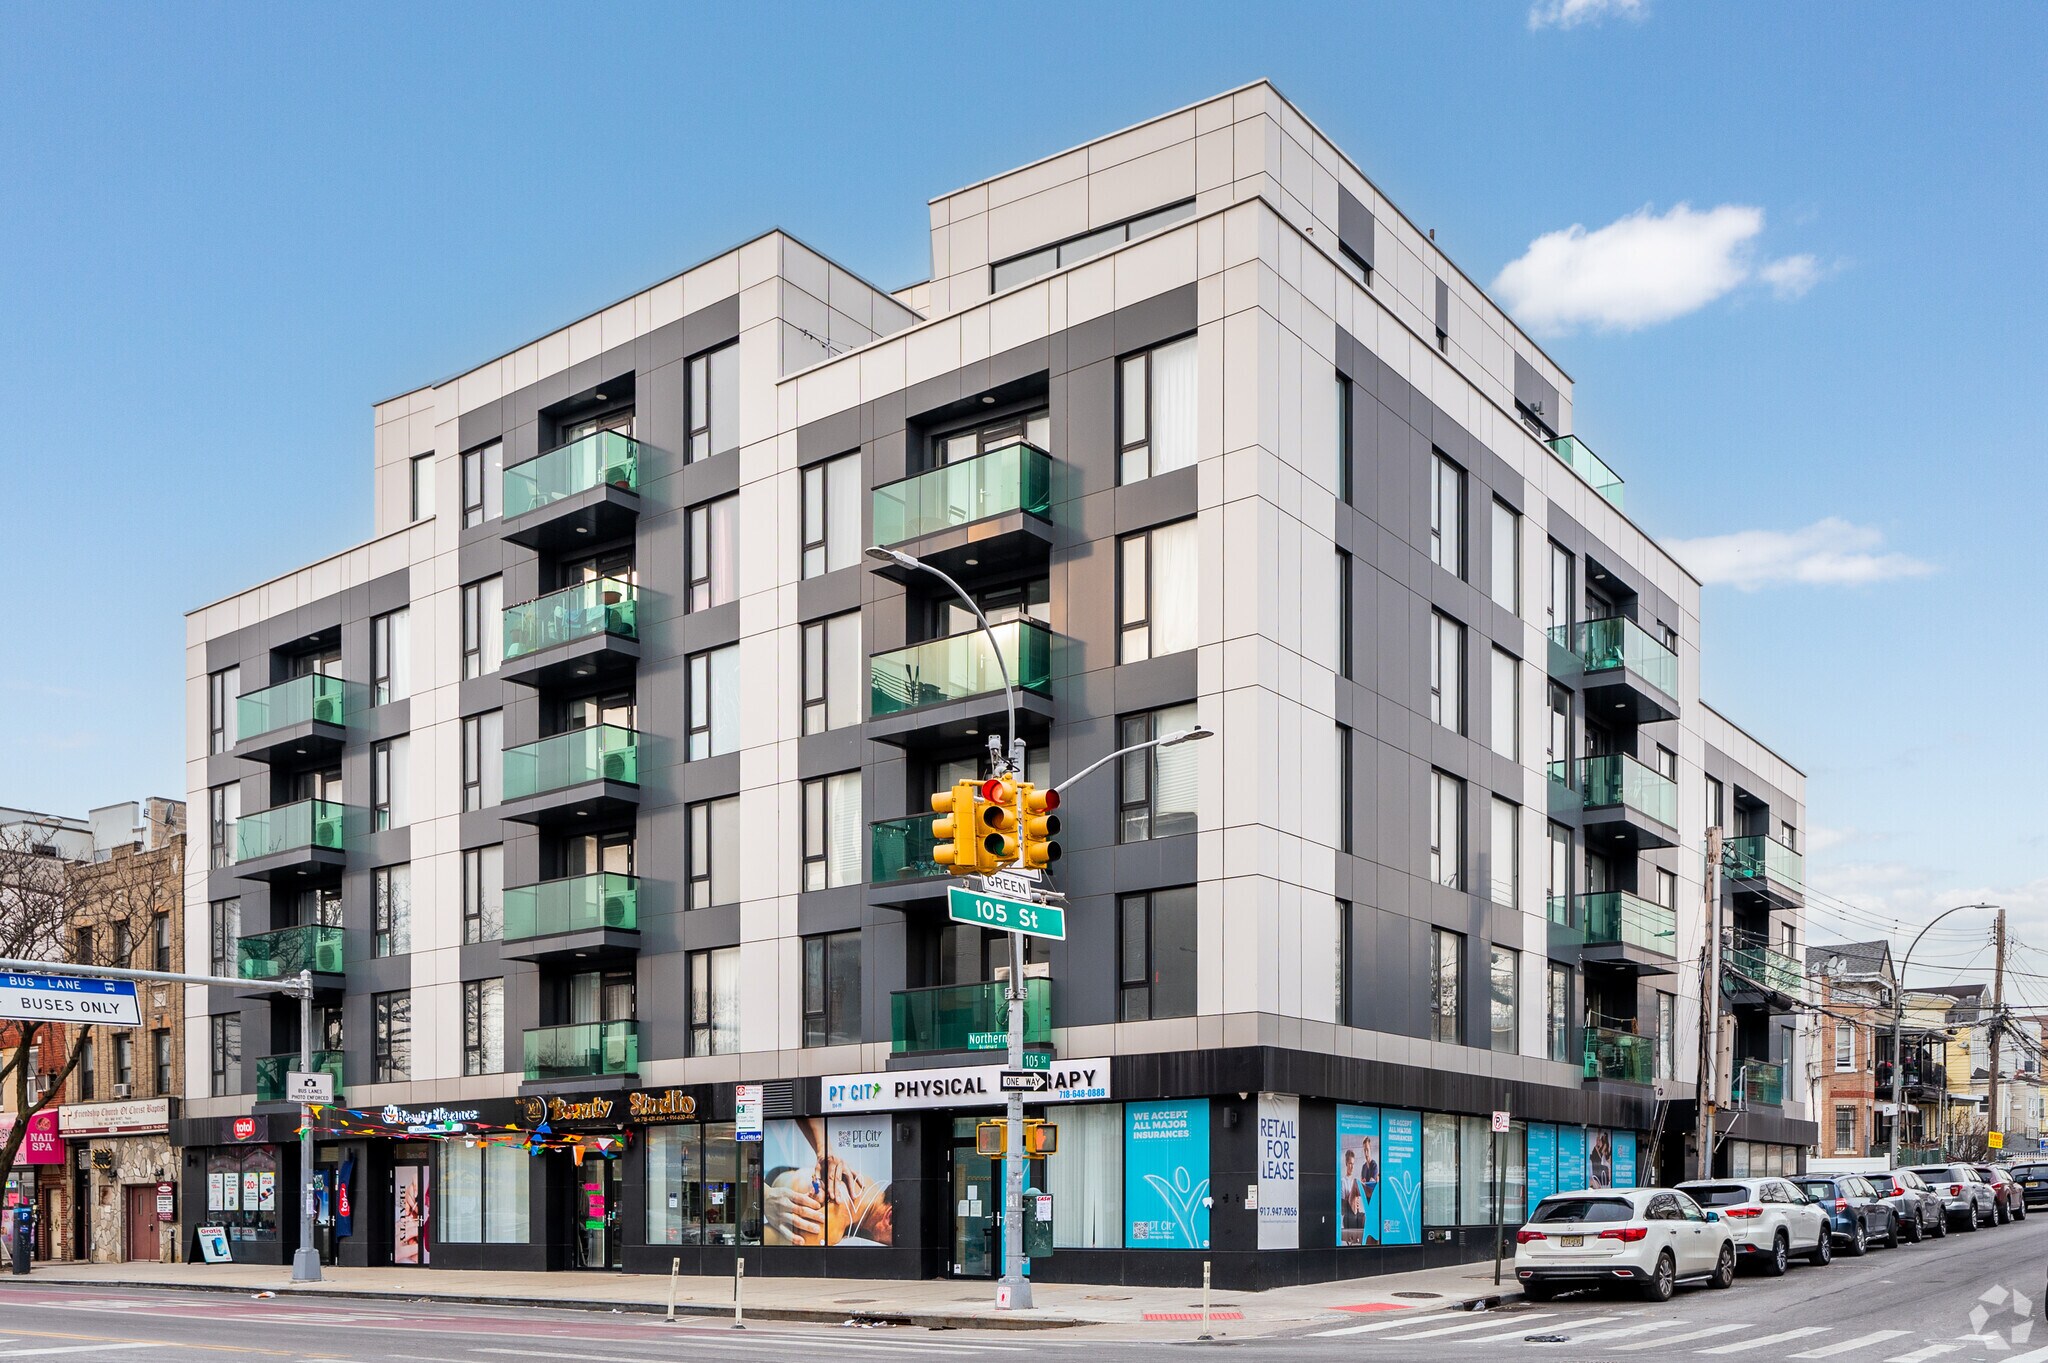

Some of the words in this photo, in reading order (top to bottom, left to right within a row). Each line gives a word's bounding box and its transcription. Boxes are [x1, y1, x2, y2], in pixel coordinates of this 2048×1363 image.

[988, 877, 1026, 894] GREEN
[975, 900, 1007, 922] 105
[1019, 908, 1038, 928] St
[9, 976, 35, 987] BUS
[48, 979, 81, 990] LANE
[21, 997, 74, 1012] BUSES
[81, 1001, 120, 1014] ONLY
[969, 1033, 1007, 1044] Northern
[1025, 1055, 1038, 1067] 105
[1041, 1055, 1046, 1063] St
[1006, 1077, 1019, 1086] ONE
[1025, 1076, 1040, 1086] WAY
[829, 1085, 845, 1101] PT
[894, 1077, 987, 1098] PHYSICAL
[1059, 1088, 1105, 1099] 718-648-0888
[101, 1107, 118, 1117] Church
[129, 1105, 145, 1115] Christ
[146, 1104, 166, 1114] Baptist
[548, 1097, 613, 1120] Beauty
[629, 1089, 696, 1116] Studio
[1133, 1112, 1149, 1120] WE
[1151, 1110, 1188, 1120] ACCEPT
[1133, 1121, 1151, 1130] ALL
[1152, 1120, 1187, 1129] MAJOR
[1260, 1118, 1296, 1139] RETAIL
[30, 1133, 55, 1142] NAIL
[853, 1130, 861, 1142] PT
[865, 1129, 882, 1142] City
[1133, 1130, 1189, 1139] INSURANCES
[32, 1142, 52, 1151] SPA
[1267, 1140, 1290, 1159] FOR
[1262, 1160, 1294, 1180] LEASE
[1260, 1206, 1297, 1216] 917.947.9056
